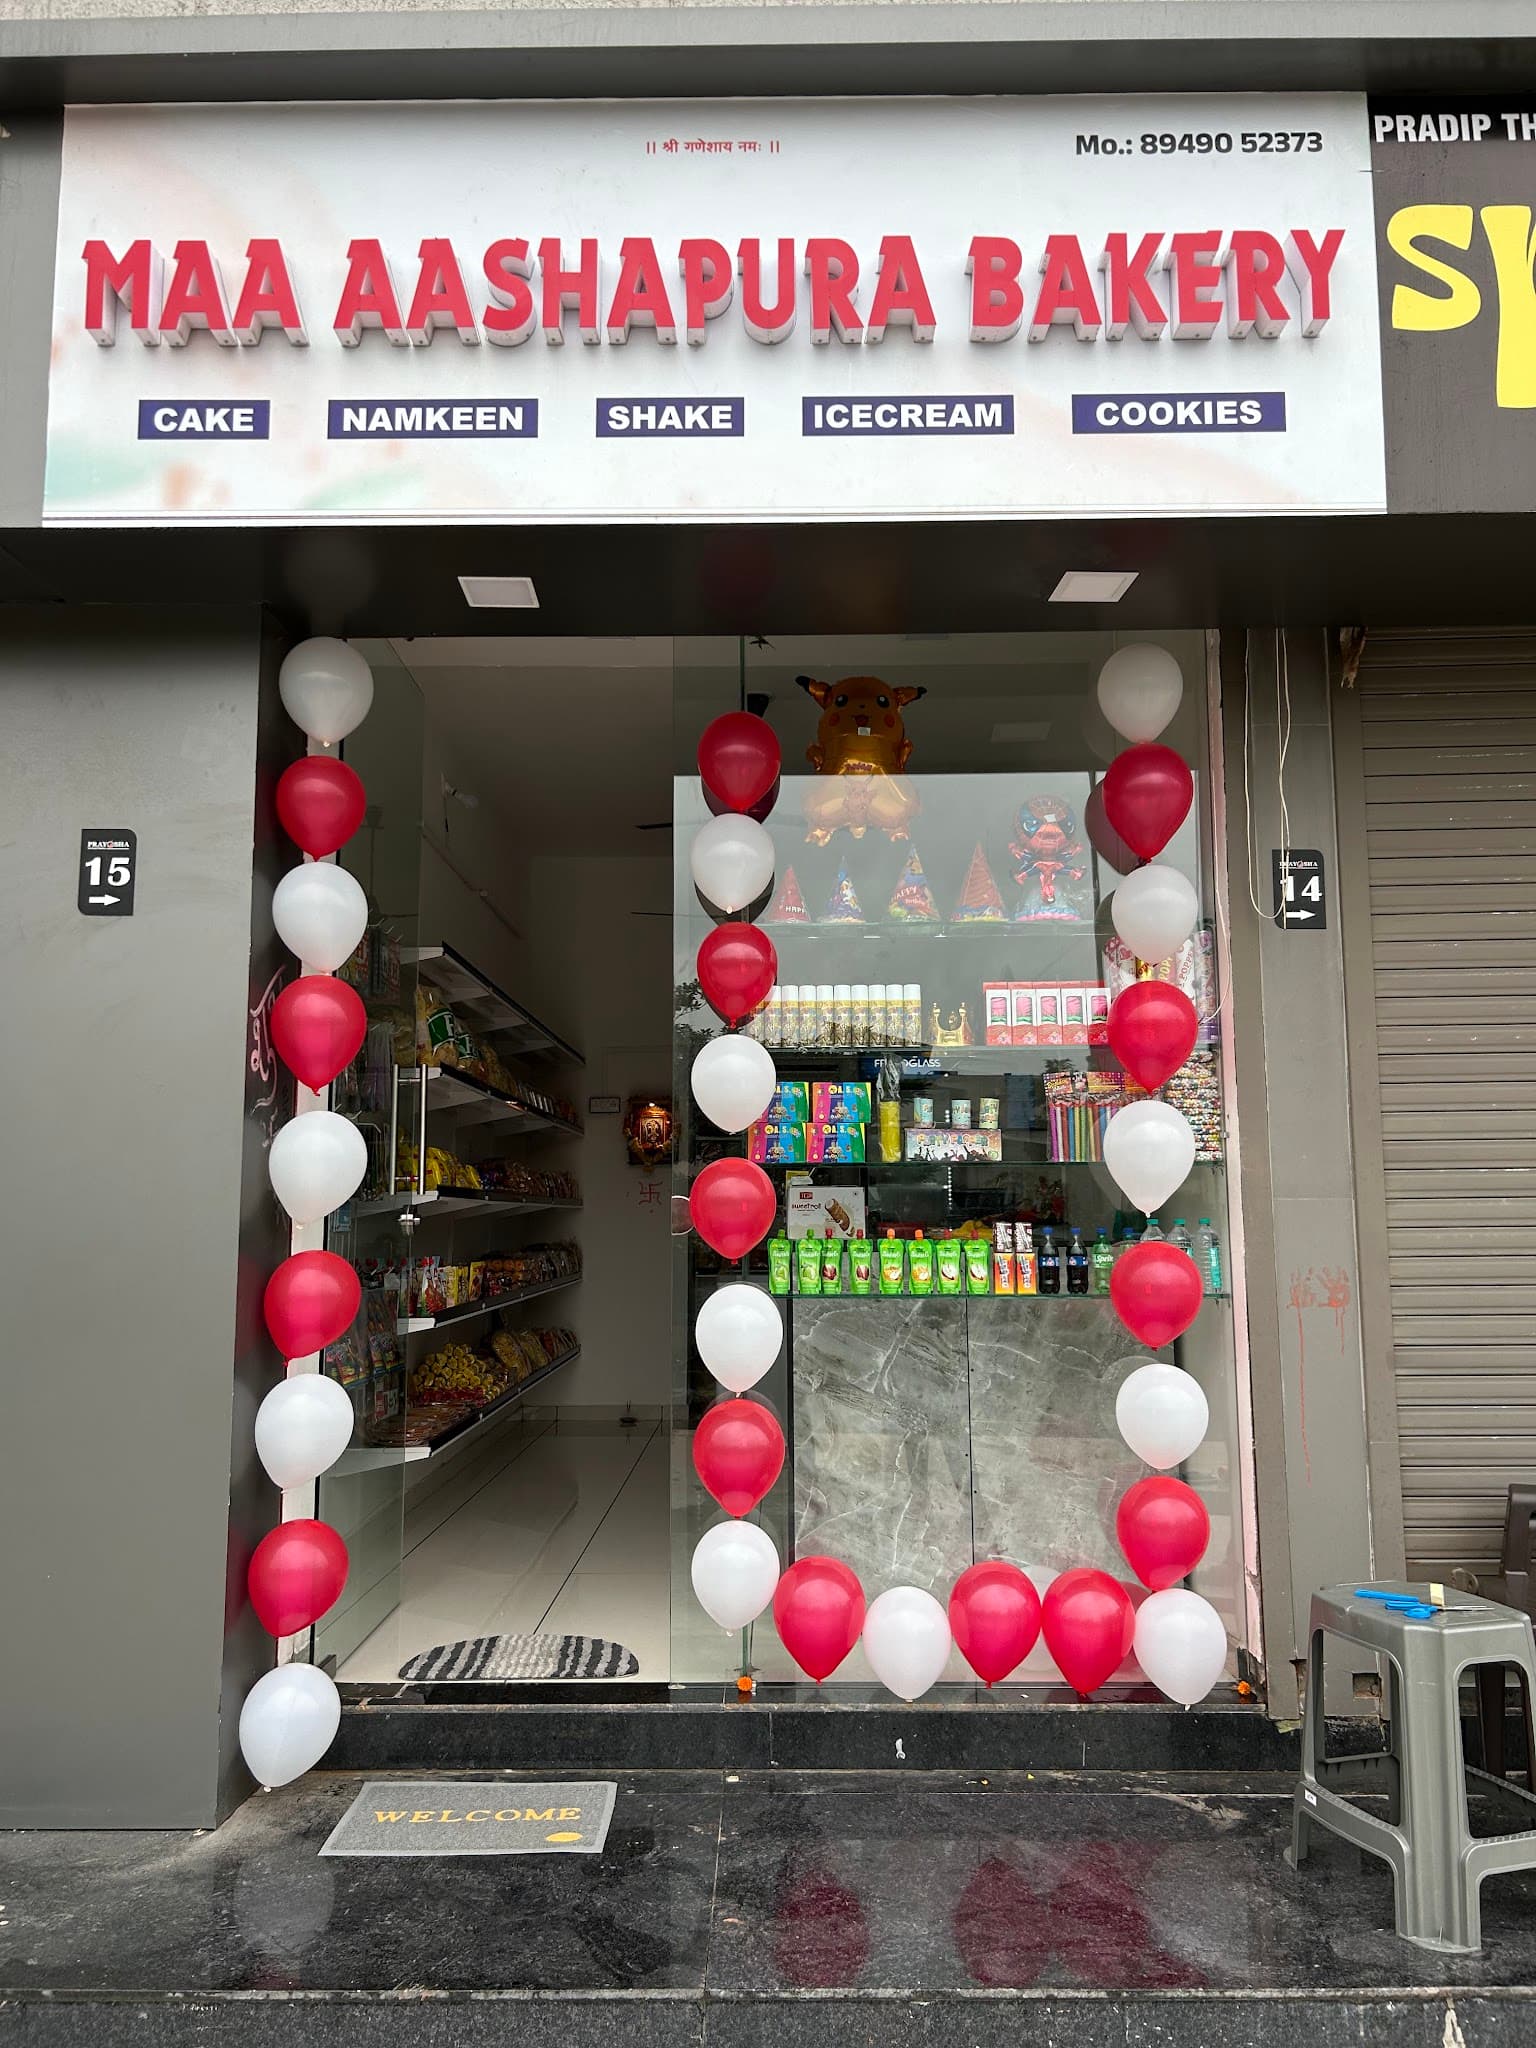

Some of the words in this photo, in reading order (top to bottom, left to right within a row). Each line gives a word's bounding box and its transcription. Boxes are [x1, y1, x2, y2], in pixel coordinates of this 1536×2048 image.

[1374, 114, 1491, 143] PRADIP
[662, 138, 679, 153] श्री
[684, 138, 733, 153] गणेशाय
[1076, 134, 1132, 155] Mo.:
[1140, 132, 1233, 154] 89490
[1240, 131, 1323, 153] 52373
[81, 239, 304, 332] MAA
[333, 235, 936, 332] AASHAPURA
[966, 229, 1346, 328] BAKERY
[153, 407, 254, 432] CAKE
[342, 406, 523, 432] NAMKEEN
[607, 405, 733, 430] SHAKE
[814, 403, 1002, 429] ICECREAM
[1095, 400, 1262, 426] COOKIES
[85, 857, 131, 887] 15
[1279, 875, 1323, 902] 14
[373, 1806, 583, 1824] WELCOME
